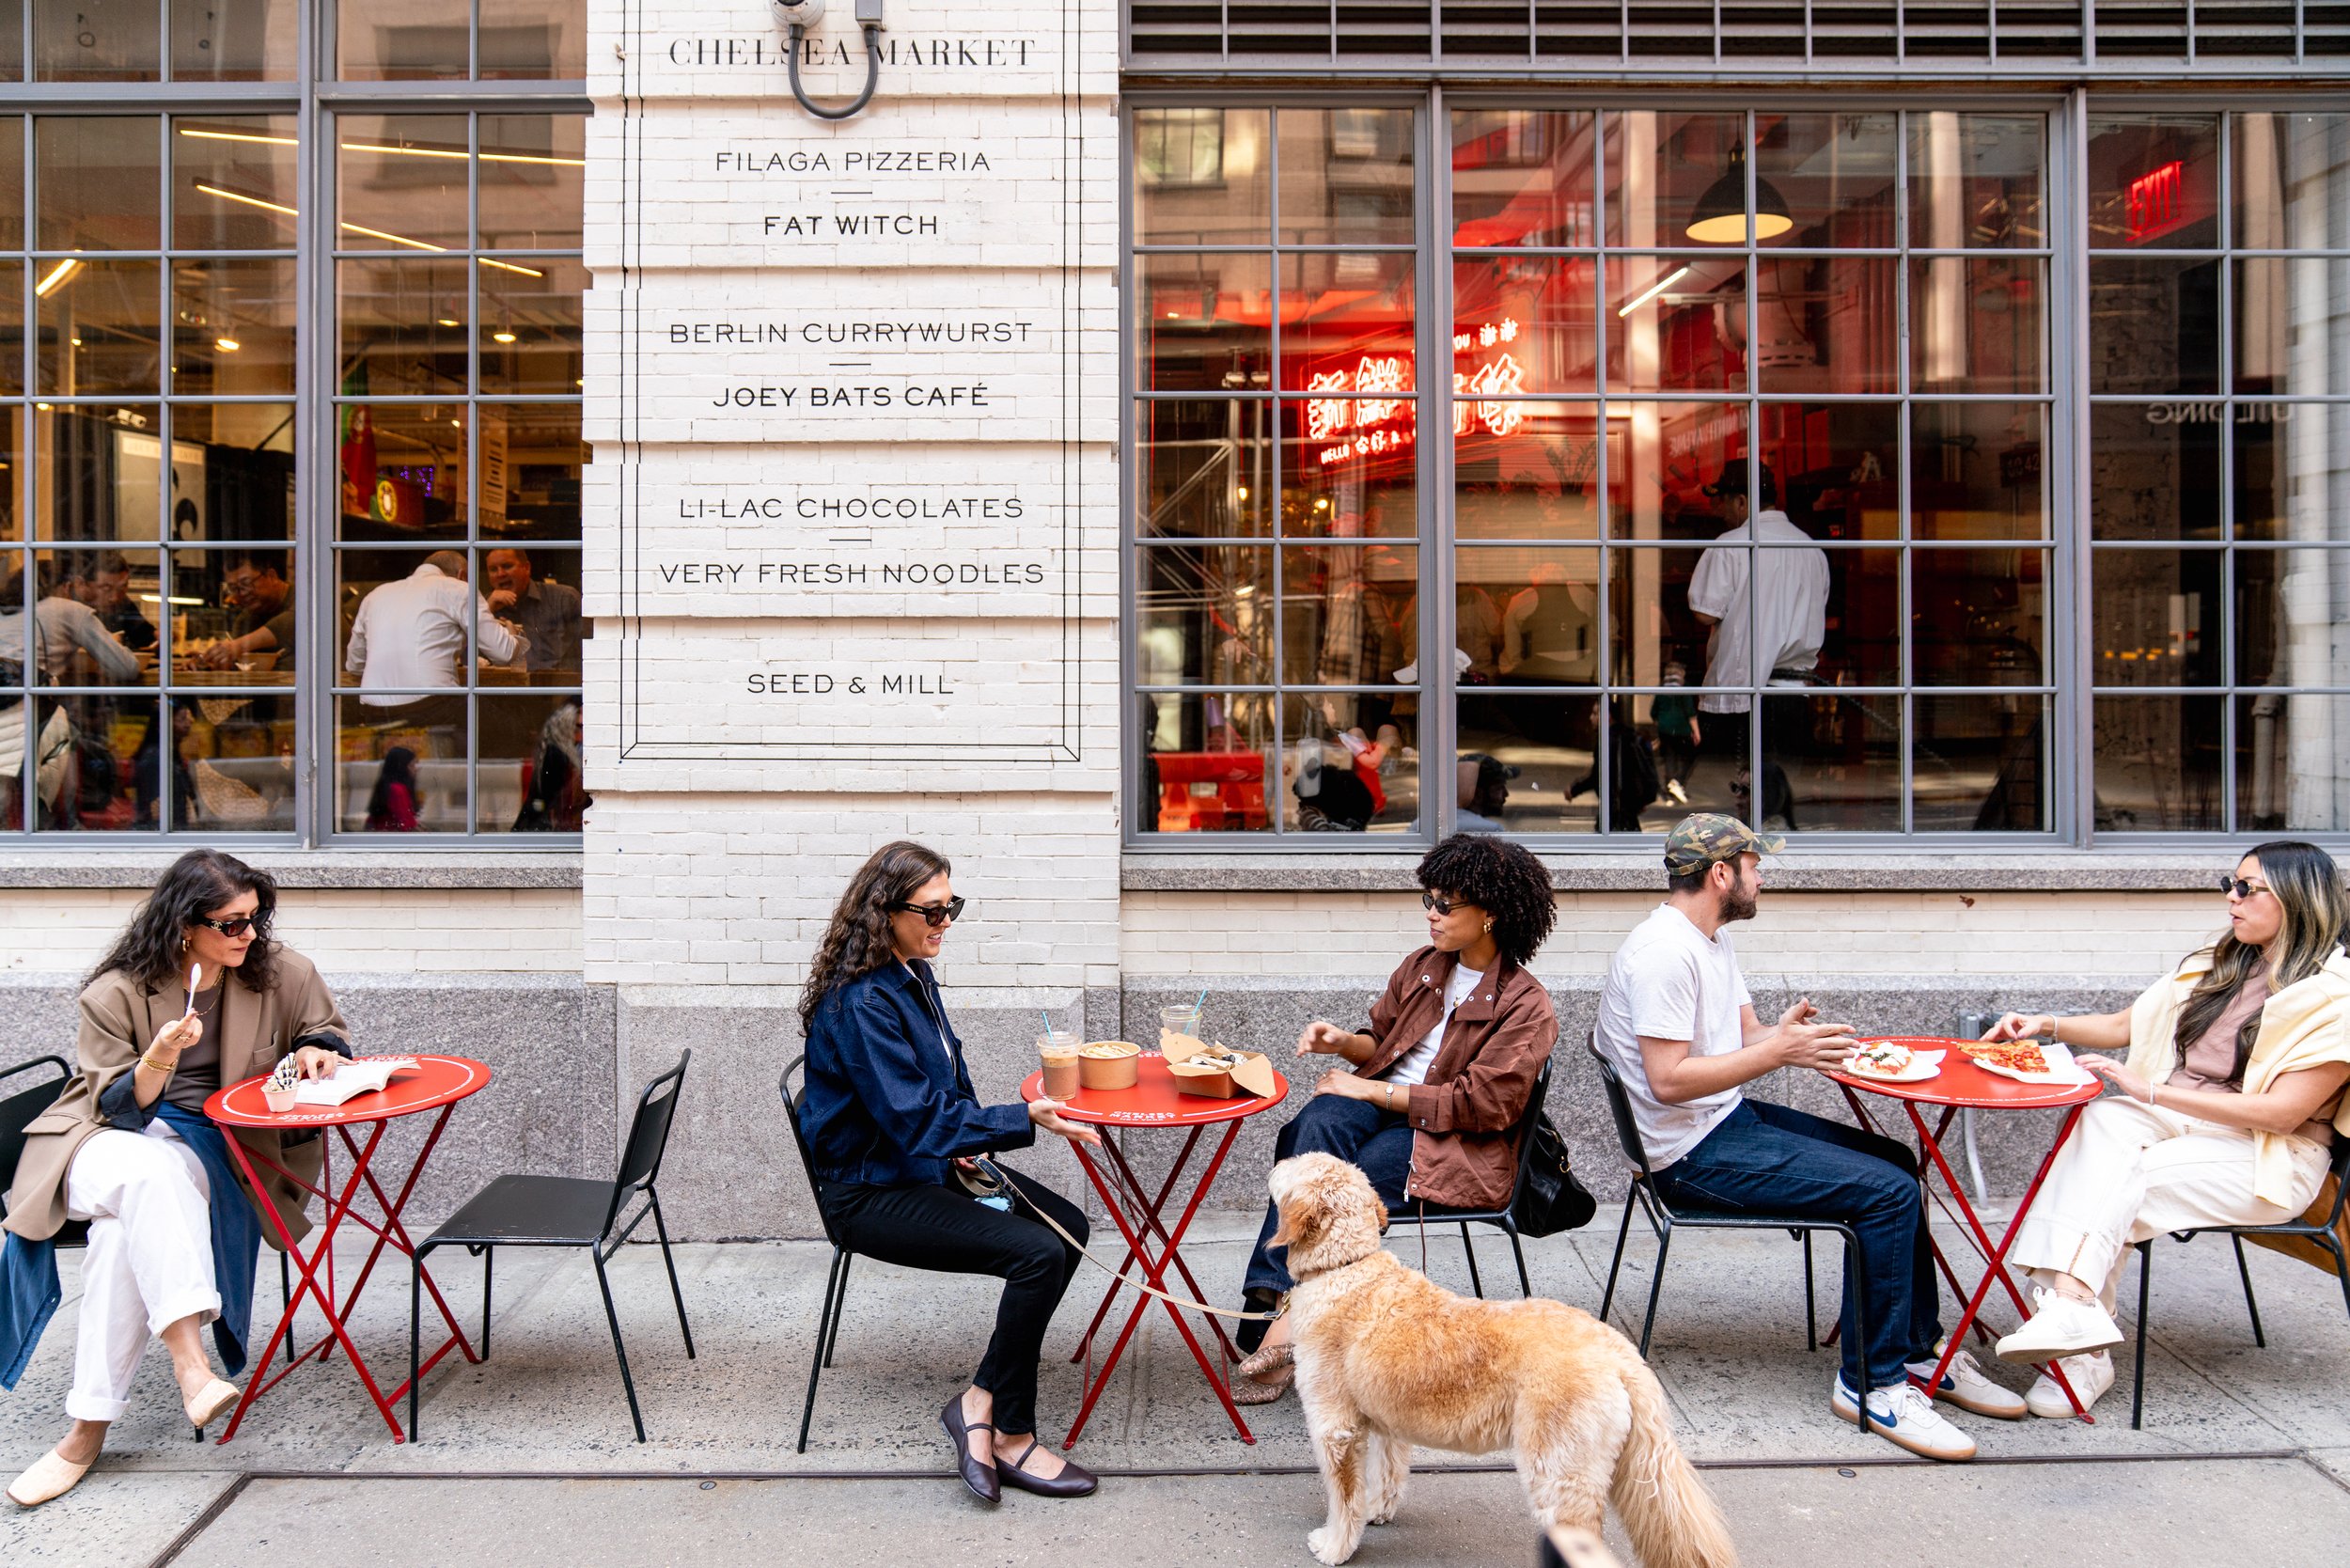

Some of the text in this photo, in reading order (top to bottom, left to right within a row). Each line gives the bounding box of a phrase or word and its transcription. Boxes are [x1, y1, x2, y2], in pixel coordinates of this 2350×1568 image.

[874, 39, 1035, 66] MARKET
[716, 151, 990, 172] FILAGA PIZZERIA
[2131, 165, 2173, 231] EXIT
[764, 214, 938, 236] FAT WITCH
[669, 322, 1032, 343] BERLIN CURRYWURST
[713, 382, 989, 408] JOEY BATS CAFÉ
[1320, 443, 1350, 464] HELLO
[680, 498, 1023, 520] LI-LAC CHOCOLATES
[659, 563, 1043, 585] VERY FRESH NOODLES
[747, 673, 954, 695] SEED & MILL
